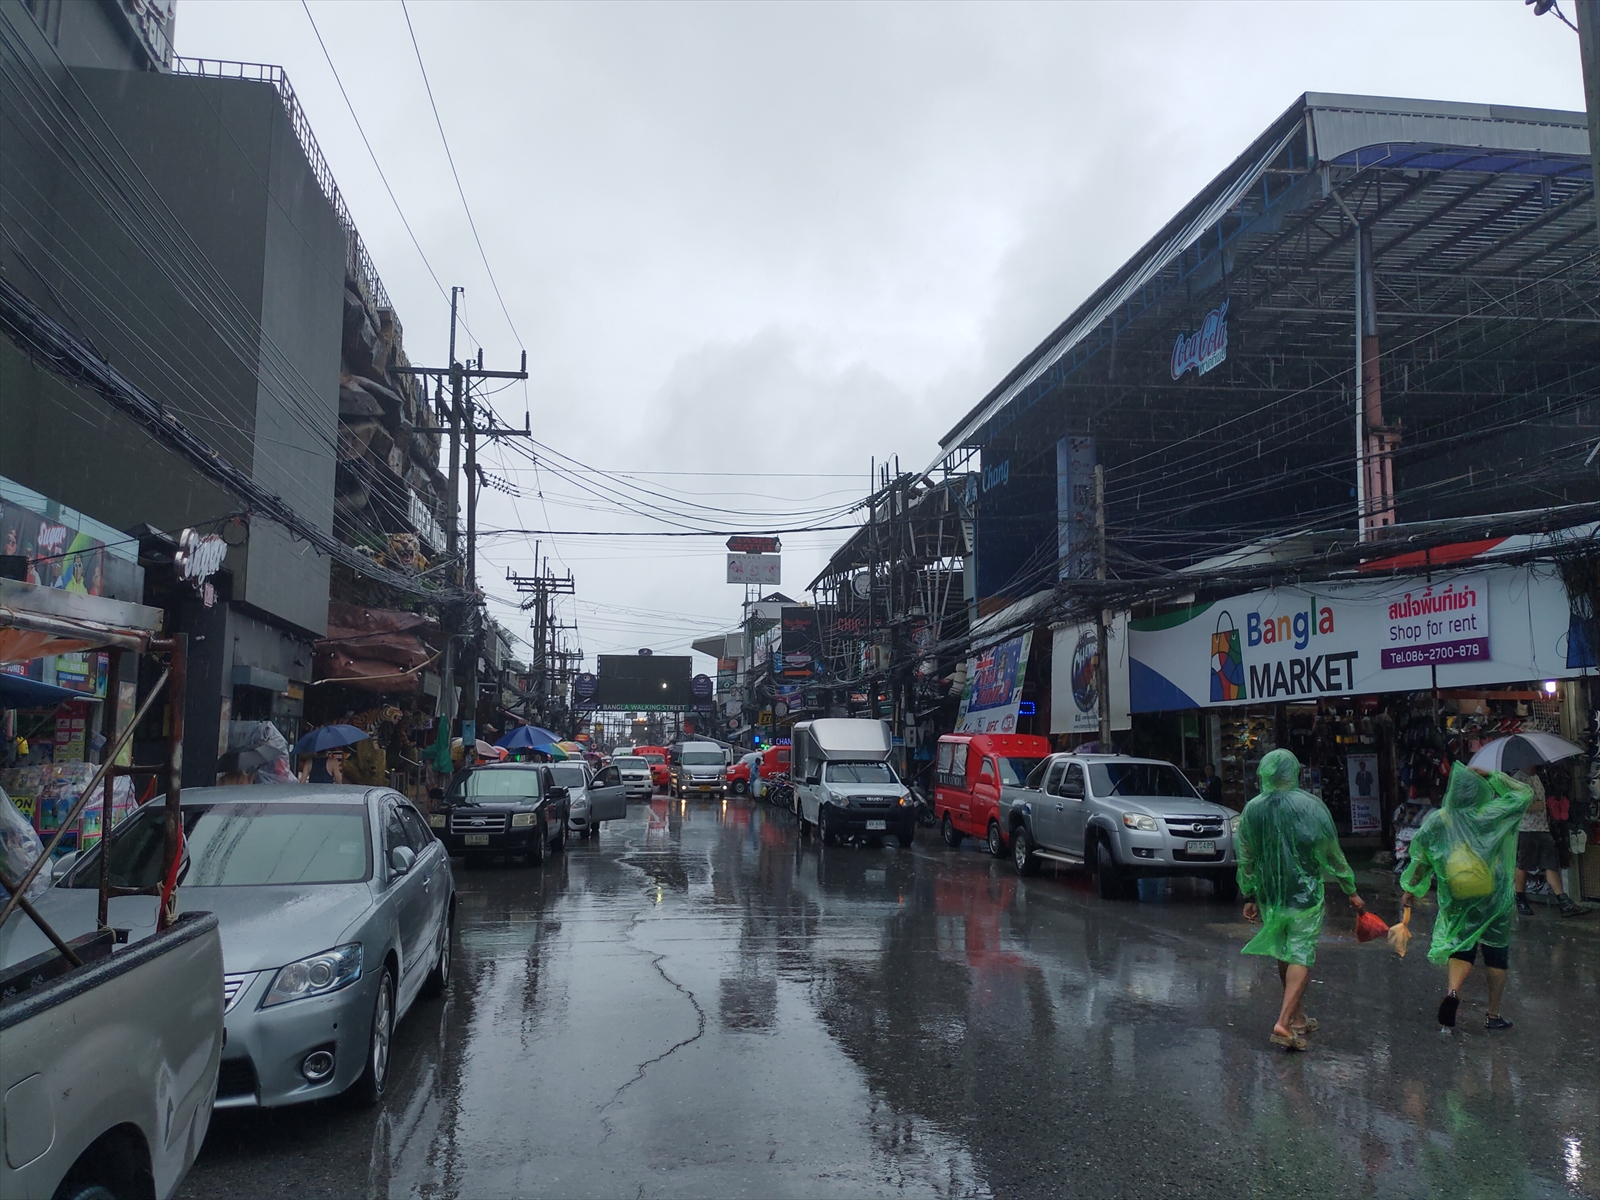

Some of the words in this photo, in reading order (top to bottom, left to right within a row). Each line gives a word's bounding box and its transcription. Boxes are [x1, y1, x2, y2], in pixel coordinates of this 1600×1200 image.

[982, 459, 1009, 493] Chang
[38, 522, 67, 550] Sugar
[1389, 584, 1476, 620] สนใจพื้นที่เช่า
[1247, 596, 1334, 650] Bangla
[1390, 625, 1421, 642] Shop
[1427, 620, 1442, 640] for
[1449, 613, 1477, 633] rent
[1390, 644, 1479, 664] Tel.086-2700-878
[20, 666, 25, 675] 9
[1250, 651, 1358, 699] MARKET
